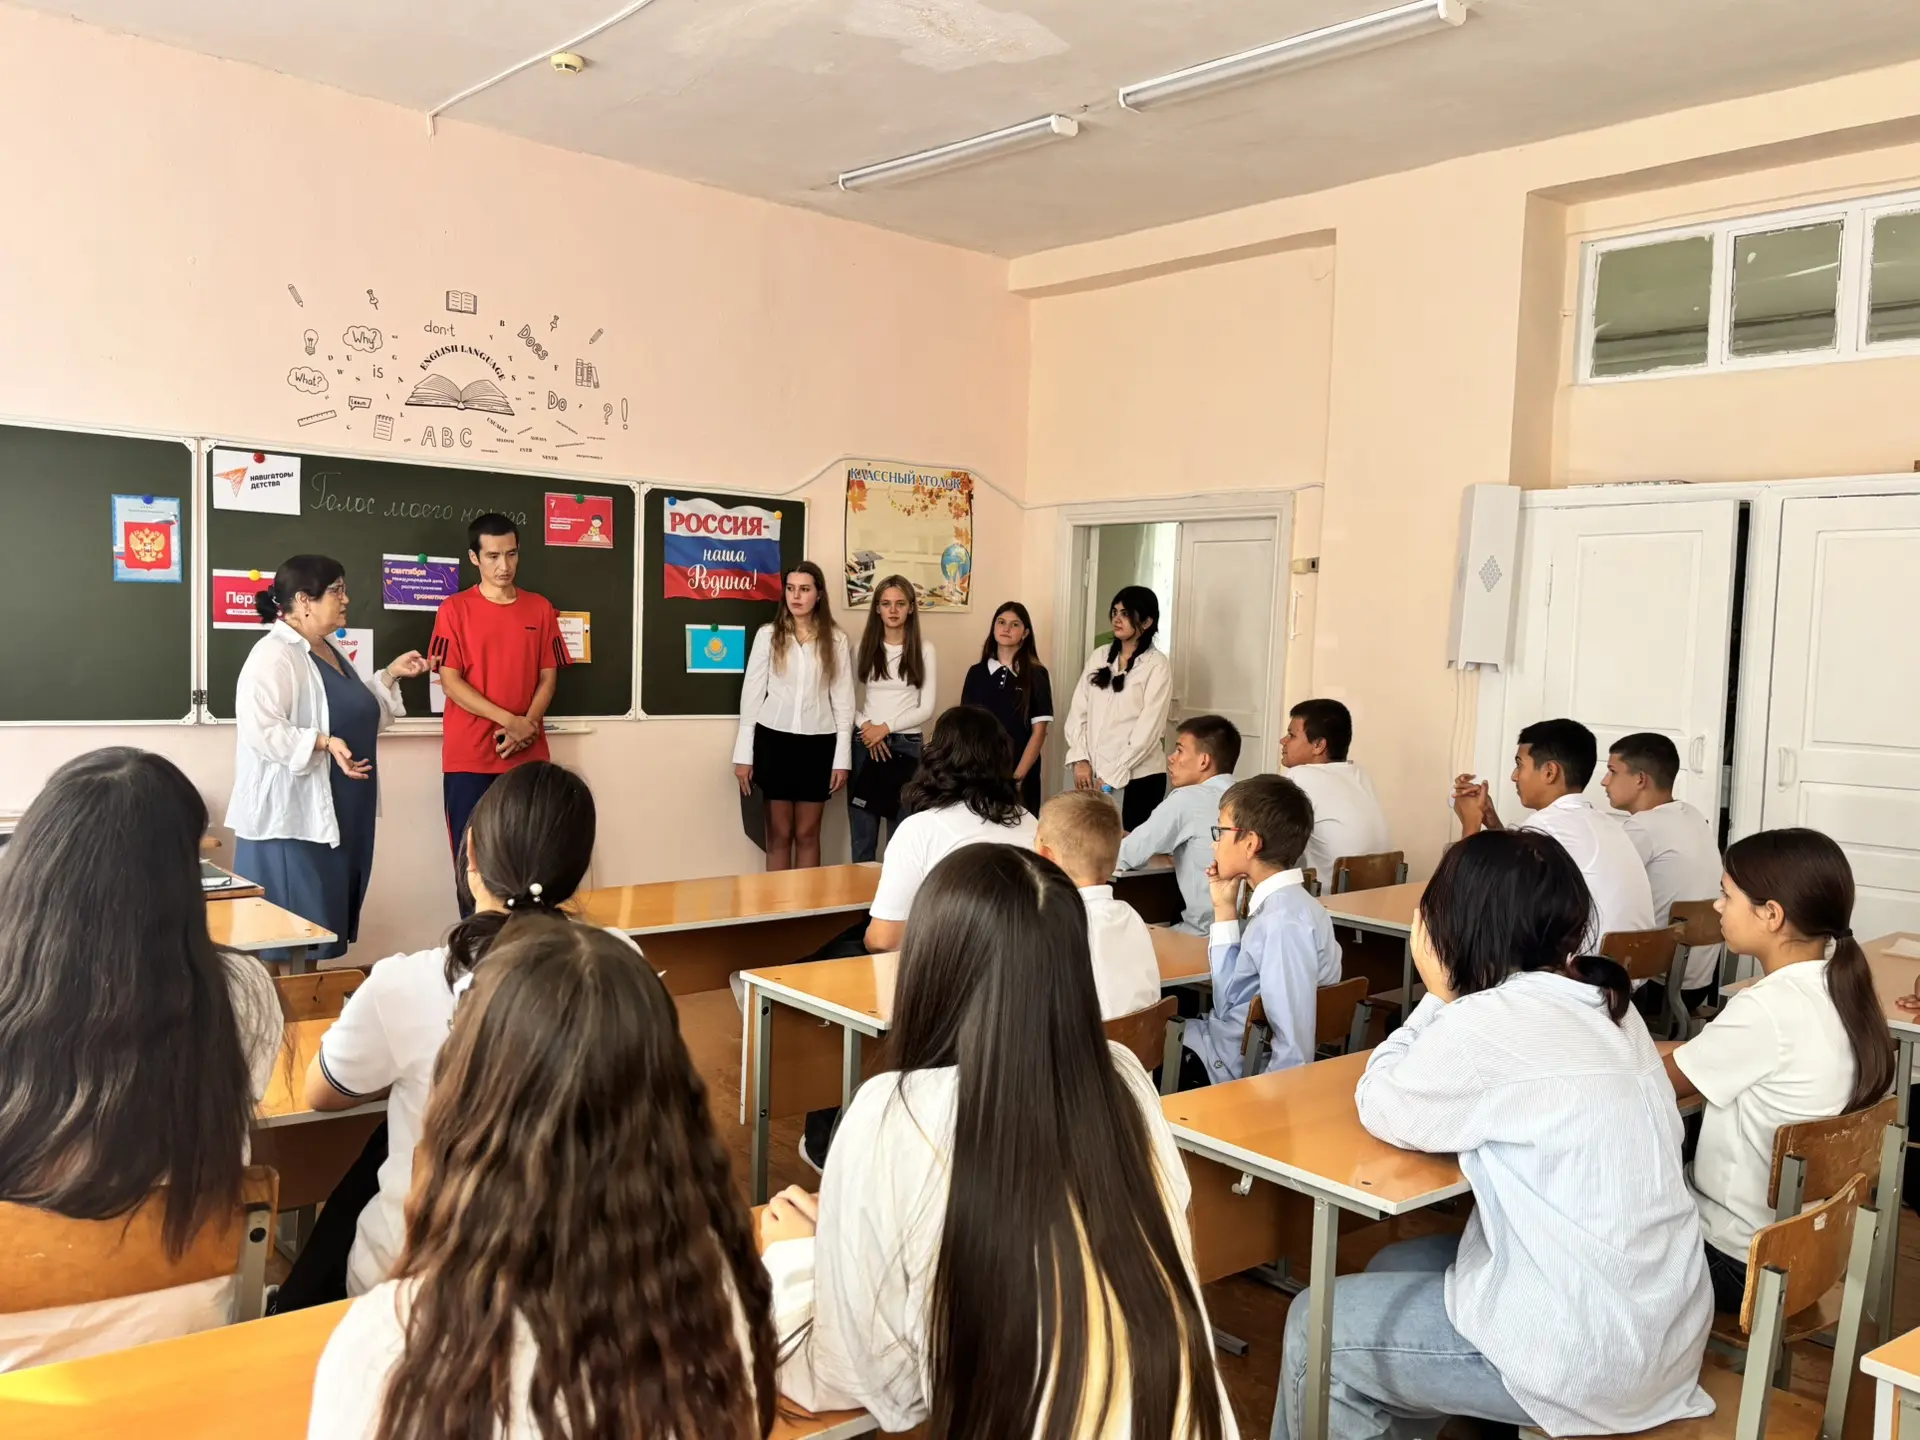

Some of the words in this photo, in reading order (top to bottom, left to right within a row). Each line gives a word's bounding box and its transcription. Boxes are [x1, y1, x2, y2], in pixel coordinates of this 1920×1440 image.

[351, 330, 378, 350] Why?
[517, 324, 549, 361] Does
[372, 364, 384, 379] is
[419, 345, 458, 371] ENGLISH
[460, 345, 506, 381] LANGUAGE
[295, 371, 323, 388] What?
[547, 390, 568, 412] Do
[250, 471, 294, 482] НАВИГАТОРЫ
[250, 480, 281, 490] ДЕТСТВА
[850, 467, 917, 485] КЛАССНЫЙ
[918, 474, 961, 490] УГОЛОК
[310, 472, 376, 516] Голос
[383, 500, 453, 521] моего
[669, 512, 770, 536] РОССИЯ-
[703, 548, 747, 563] наша
[687, 564, 758, 597] Родина!
[226, 591, 257, 608] Пер
